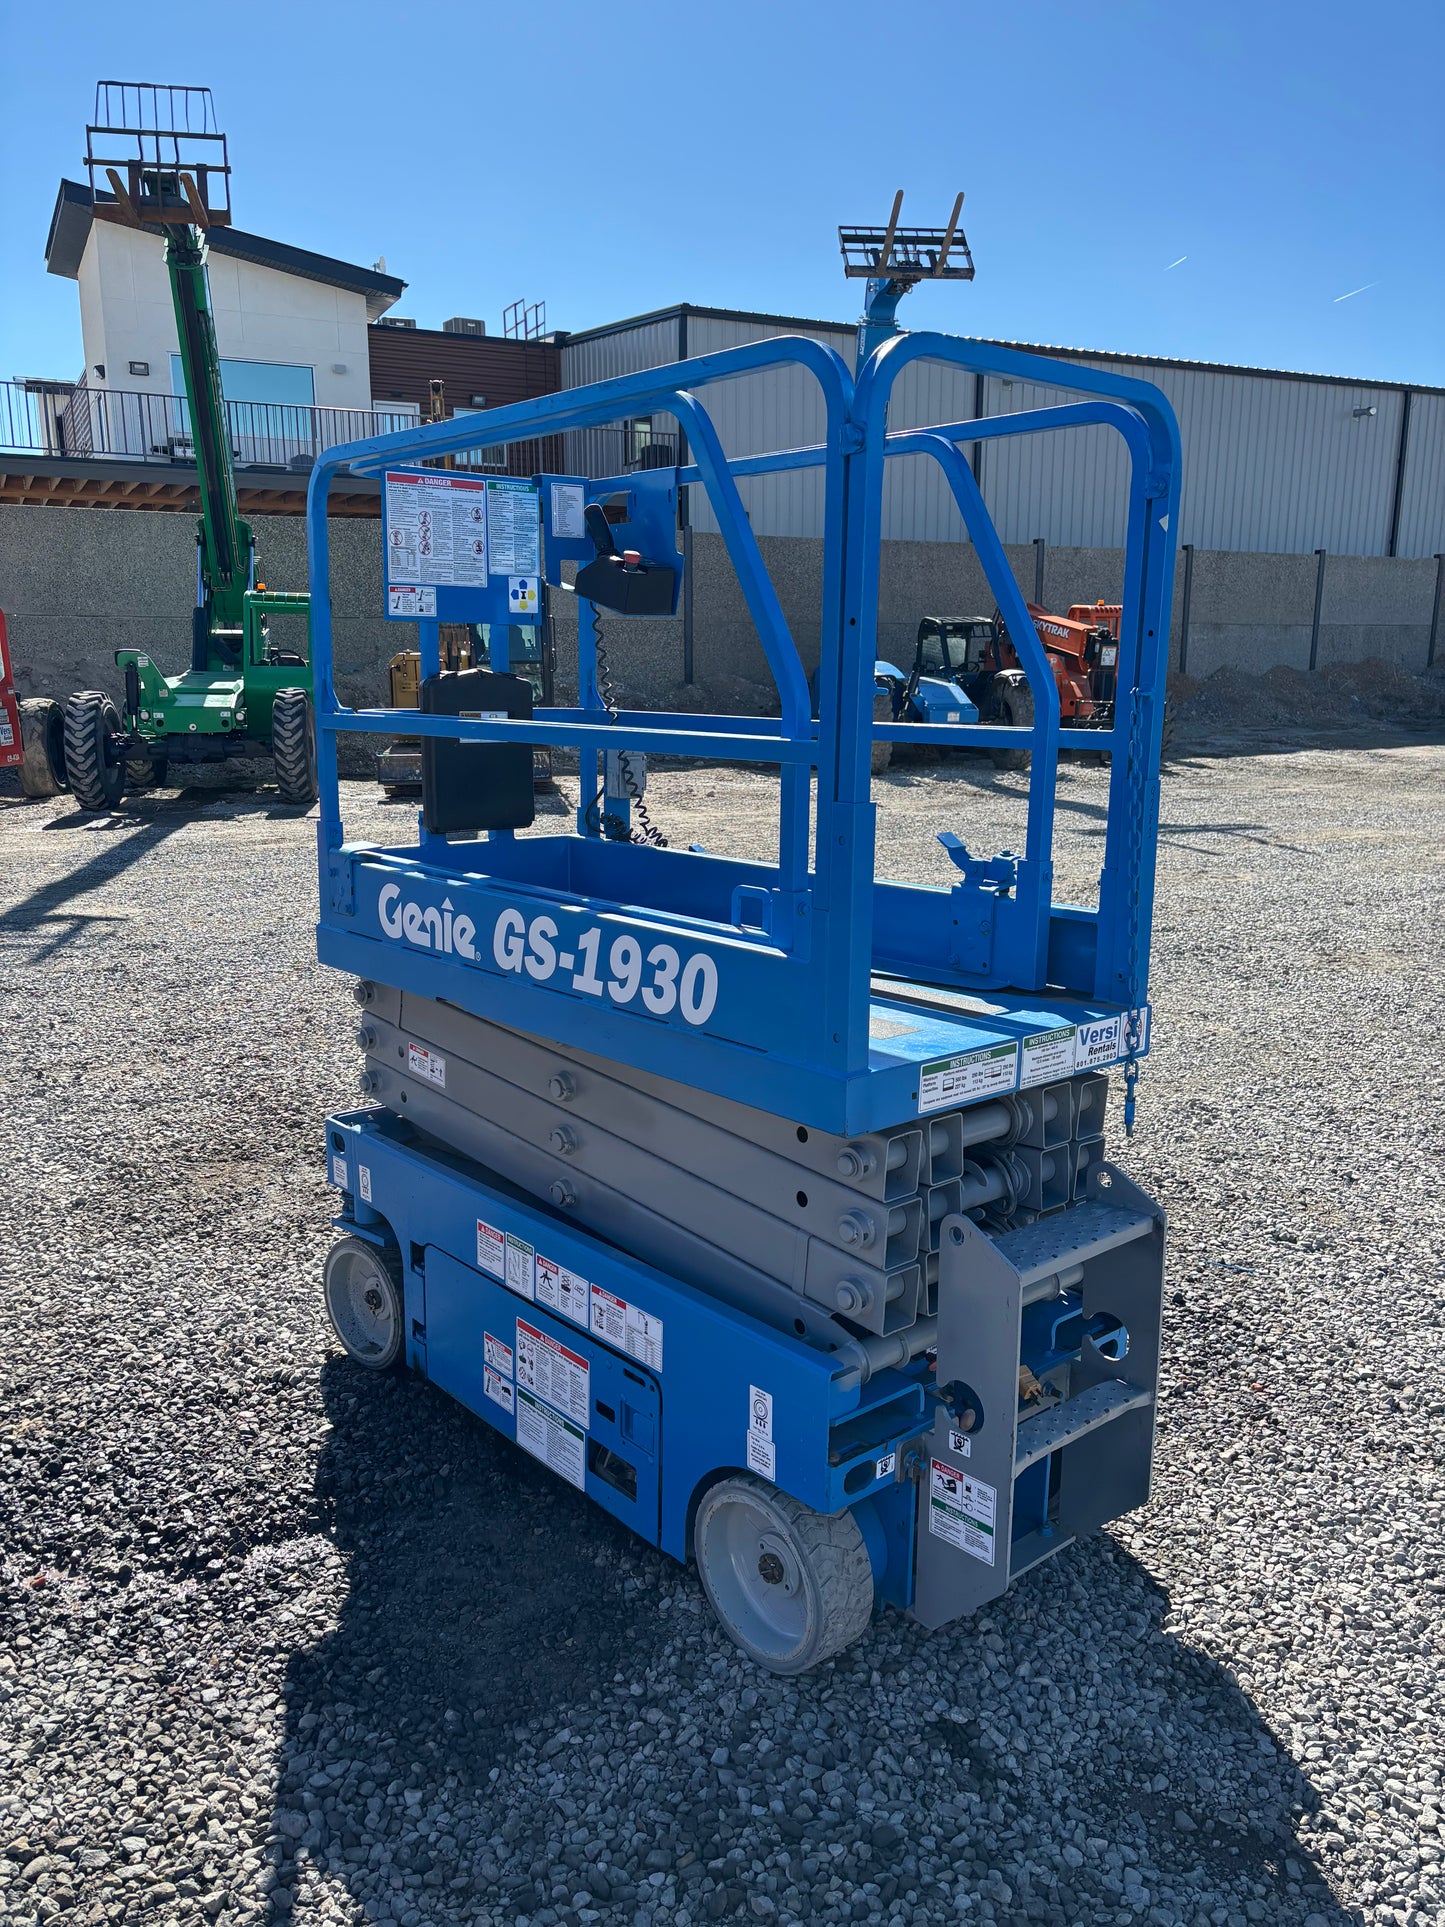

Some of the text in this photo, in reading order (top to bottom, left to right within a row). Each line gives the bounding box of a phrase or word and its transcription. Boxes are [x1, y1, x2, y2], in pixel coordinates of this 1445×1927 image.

[424, 477, 452, 487] DANGER
[495, 483, 530, 492] INSTRUCTIONS
[1033, 619, 1070, 639] SKYTRAK
[378, 882, 718, 1025] Genie GS-1930
[1029, 1029, 1070, 1045] INSTRUCTIONS
[1080, 1020, 1118, 1046] Versi
[1088, 1041, 1116, 1056] Rentals
[949, 1051, 992, 1068] INSTRUCTIONS
[1076, 1051, 1117, 1068] 801.875.2903
[485, 1227, 501, 1243] DANGER
[542, 1260, 557, 1274] DANGER
[544, 1336, 562, 1353] DANGER
[940, 1464, 961, 1480] DANGER
[945, 1505, 979, 1528] INSTRUCTIONS
